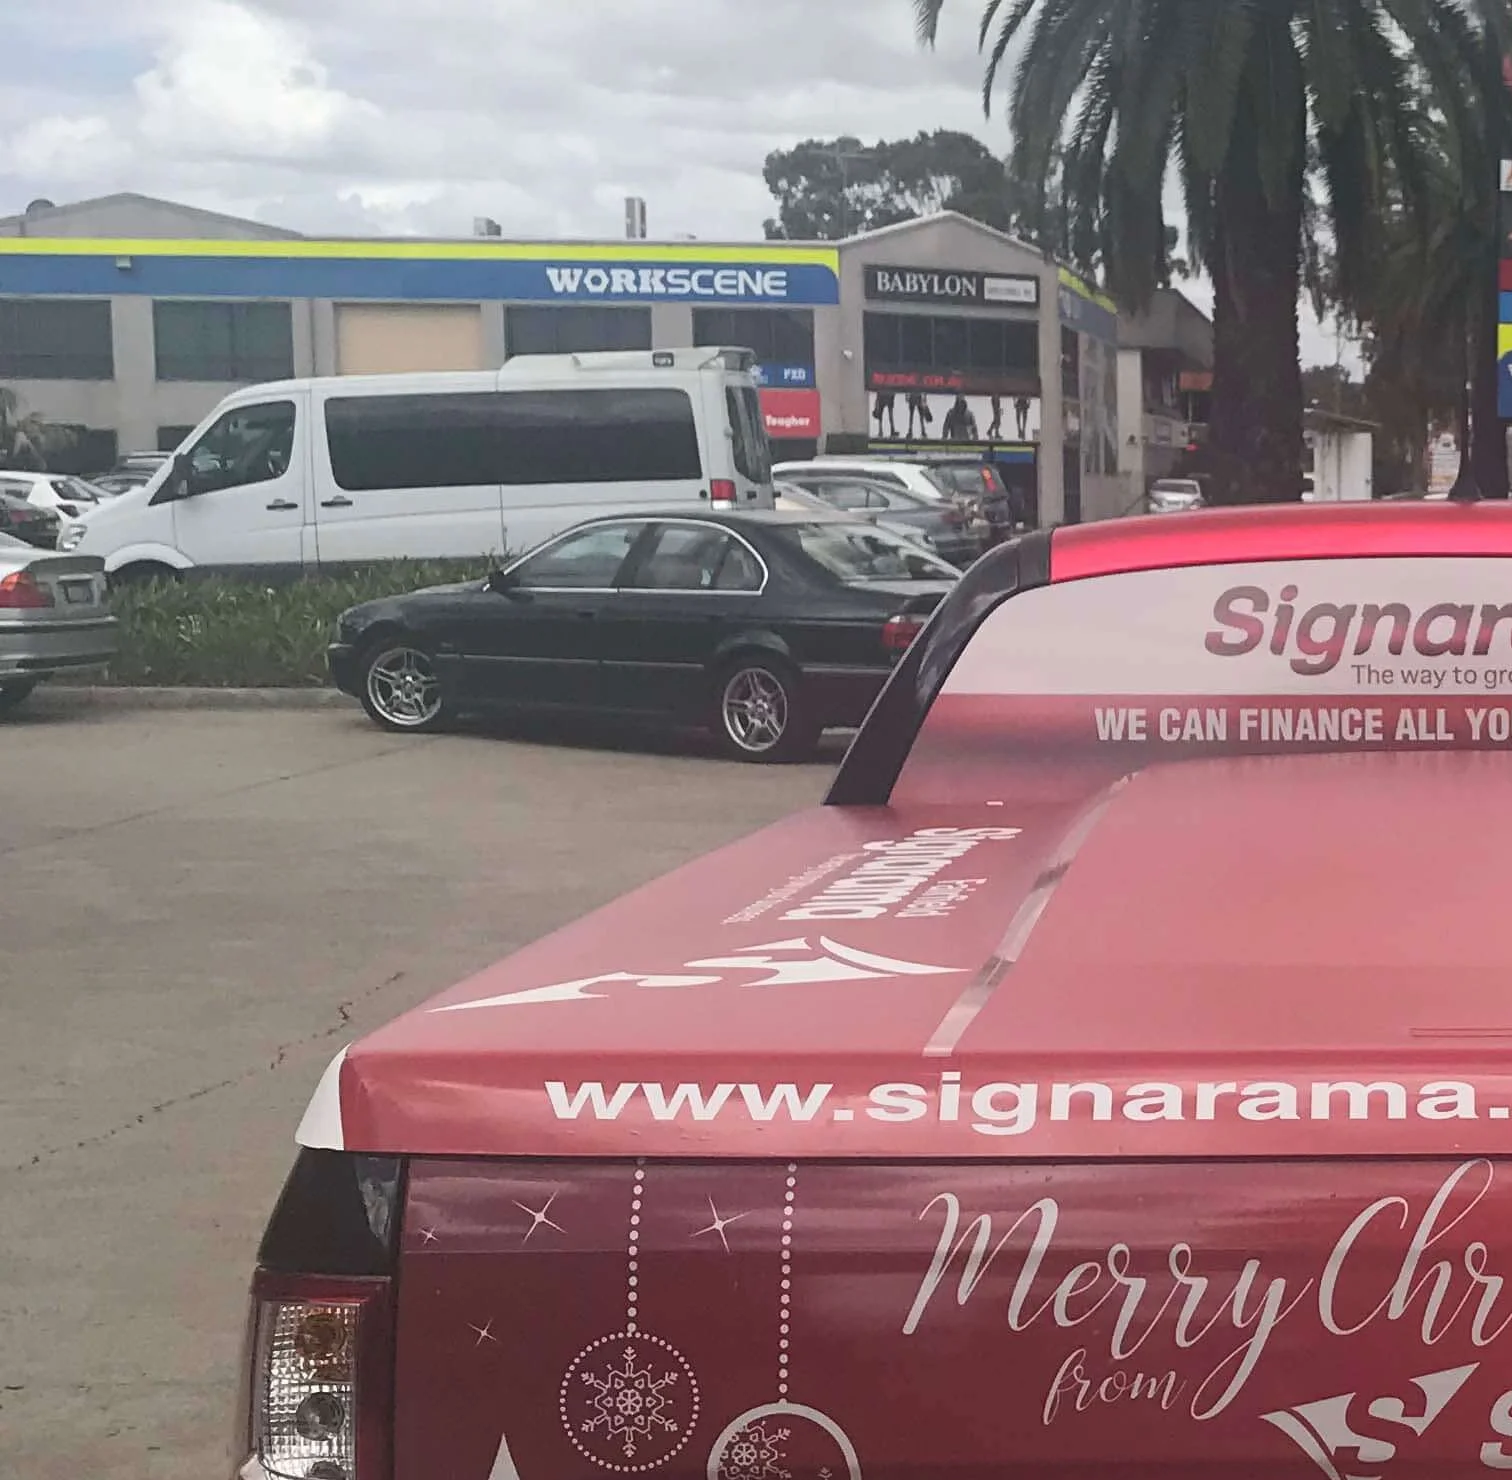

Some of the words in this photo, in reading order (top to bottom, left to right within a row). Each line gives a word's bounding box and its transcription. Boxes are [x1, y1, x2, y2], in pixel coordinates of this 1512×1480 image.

[546, 267, 787, 297] WORKSCENE
[876, 271, 977, 296] BABYLON
[1351, 664, 1394, 685] The
[1401, 669, 1447, 690] way
[1452, 666, 1478, 685] to
[1094, 708, 1147, 741] WE
[1160, 708, 1227, 741] CAN
[1240, 708, 1384, 741] FINANCE
[1395, 708, 1454, 741] ALL
[779, 826, 1022, 921] Signarama
[903, 1192, 1314, 1420] Merry
[1043, 1348, 1188, 1426] from
